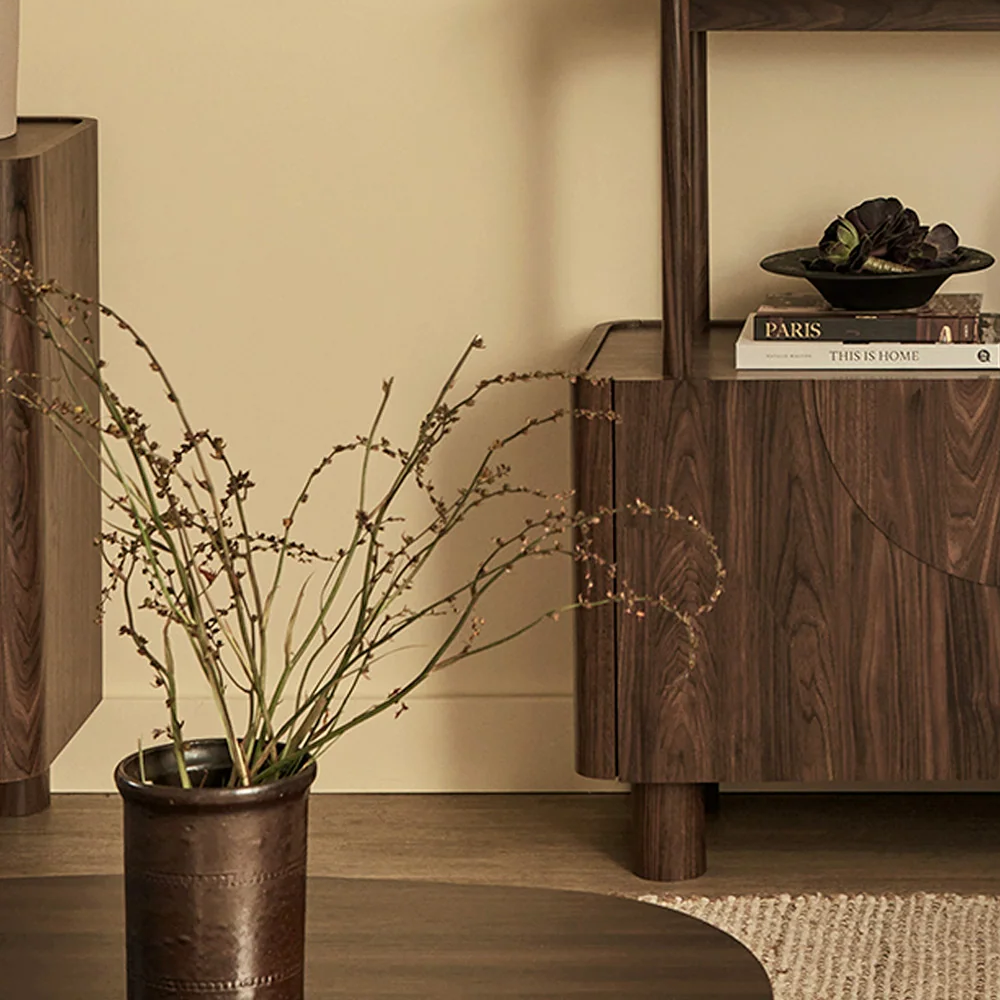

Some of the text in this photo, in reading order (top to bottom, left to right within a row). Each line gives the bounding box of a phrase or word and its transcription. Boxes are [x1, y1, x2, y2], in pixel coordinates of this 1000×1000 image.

[764, 321, 822, 339] PARIS
[829, 350, 920, 362] THIS IS HOME
